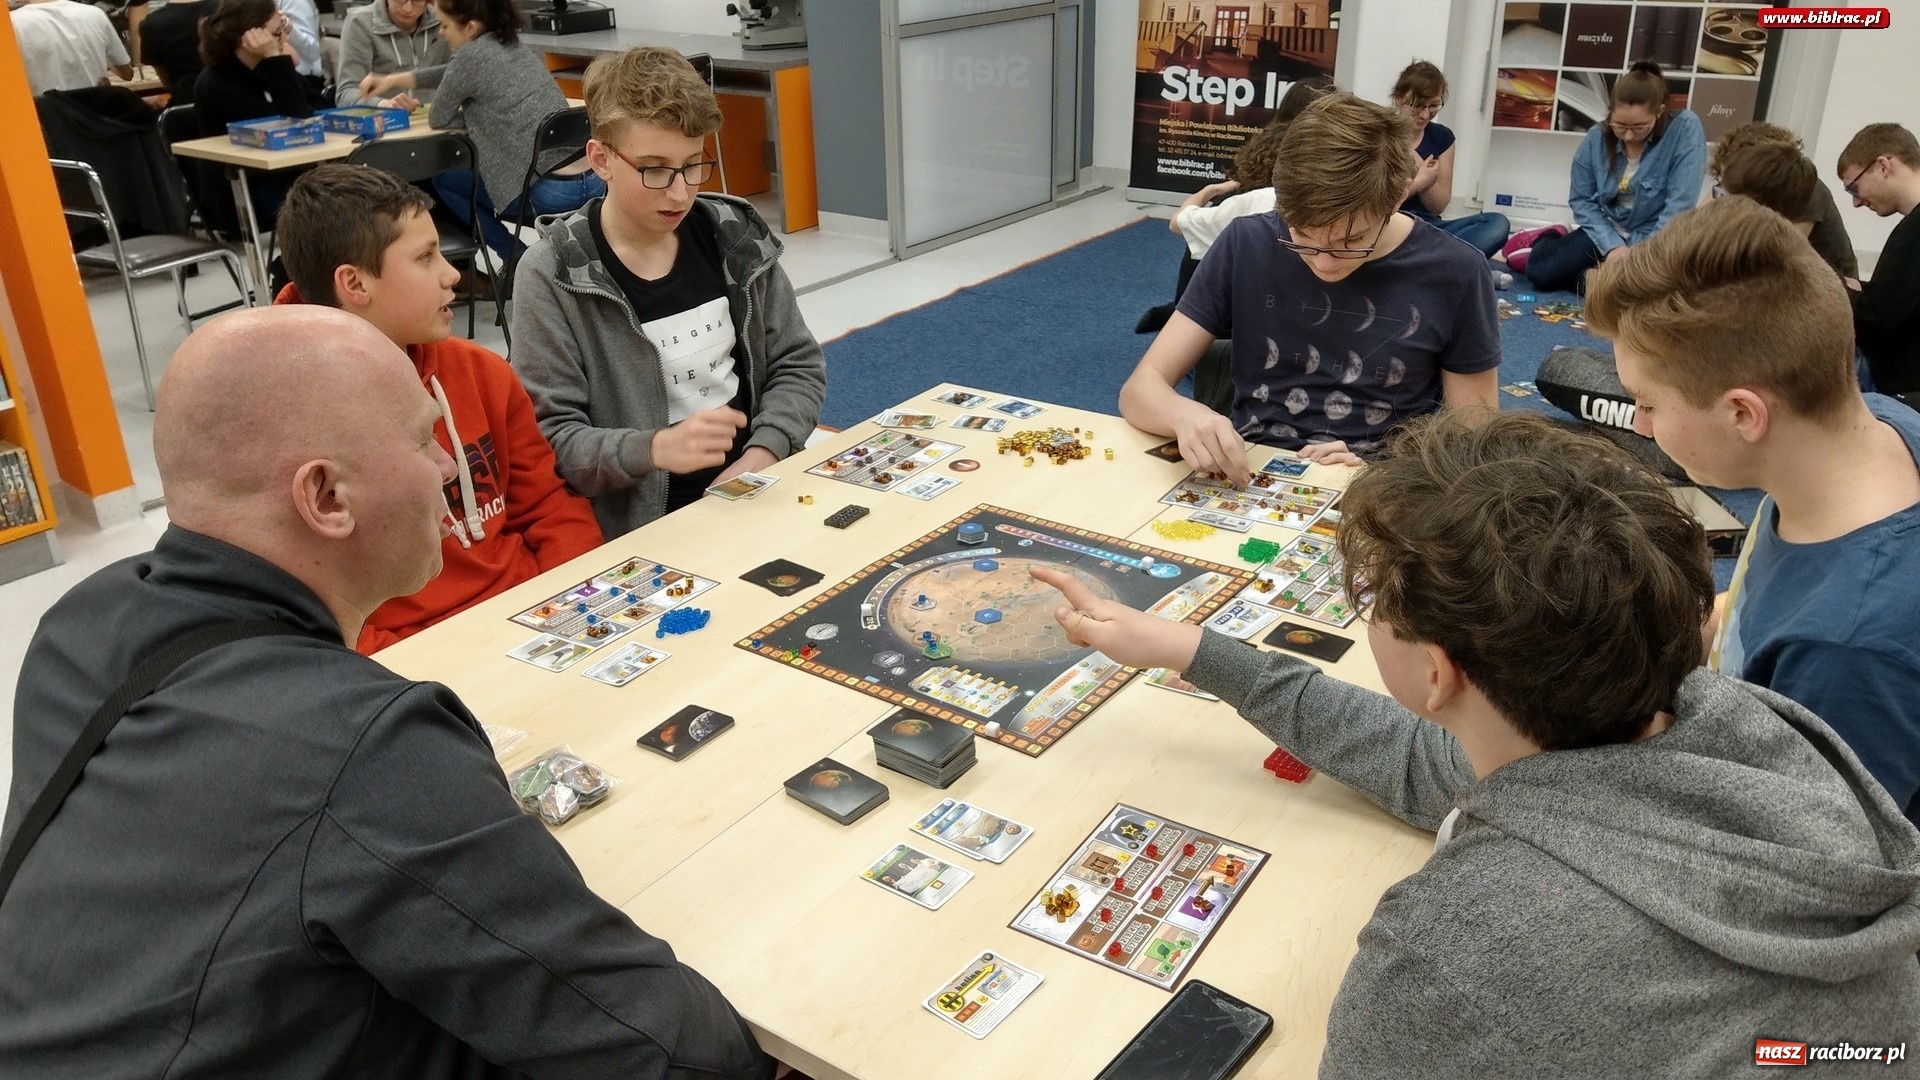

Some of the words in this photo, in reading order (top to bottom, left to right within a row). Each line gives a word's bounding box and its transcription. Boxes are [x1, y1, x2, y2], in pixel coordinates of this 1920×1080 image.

[1577, 32, 1613, 46] muzyka
[1160, 65, 1255, 116] Step
[1707, 104, 1736, 118] filmy
[1159, 118, 1185, 128] Miejska
[1189, 121, 1226, 131] Powiatowa
[1227, 124, 1264, 134] Biblioteka
[1216, 132, 1245, 141] Raciborzu
[1157, 158, 1214, 170] www.biblrac.pl
